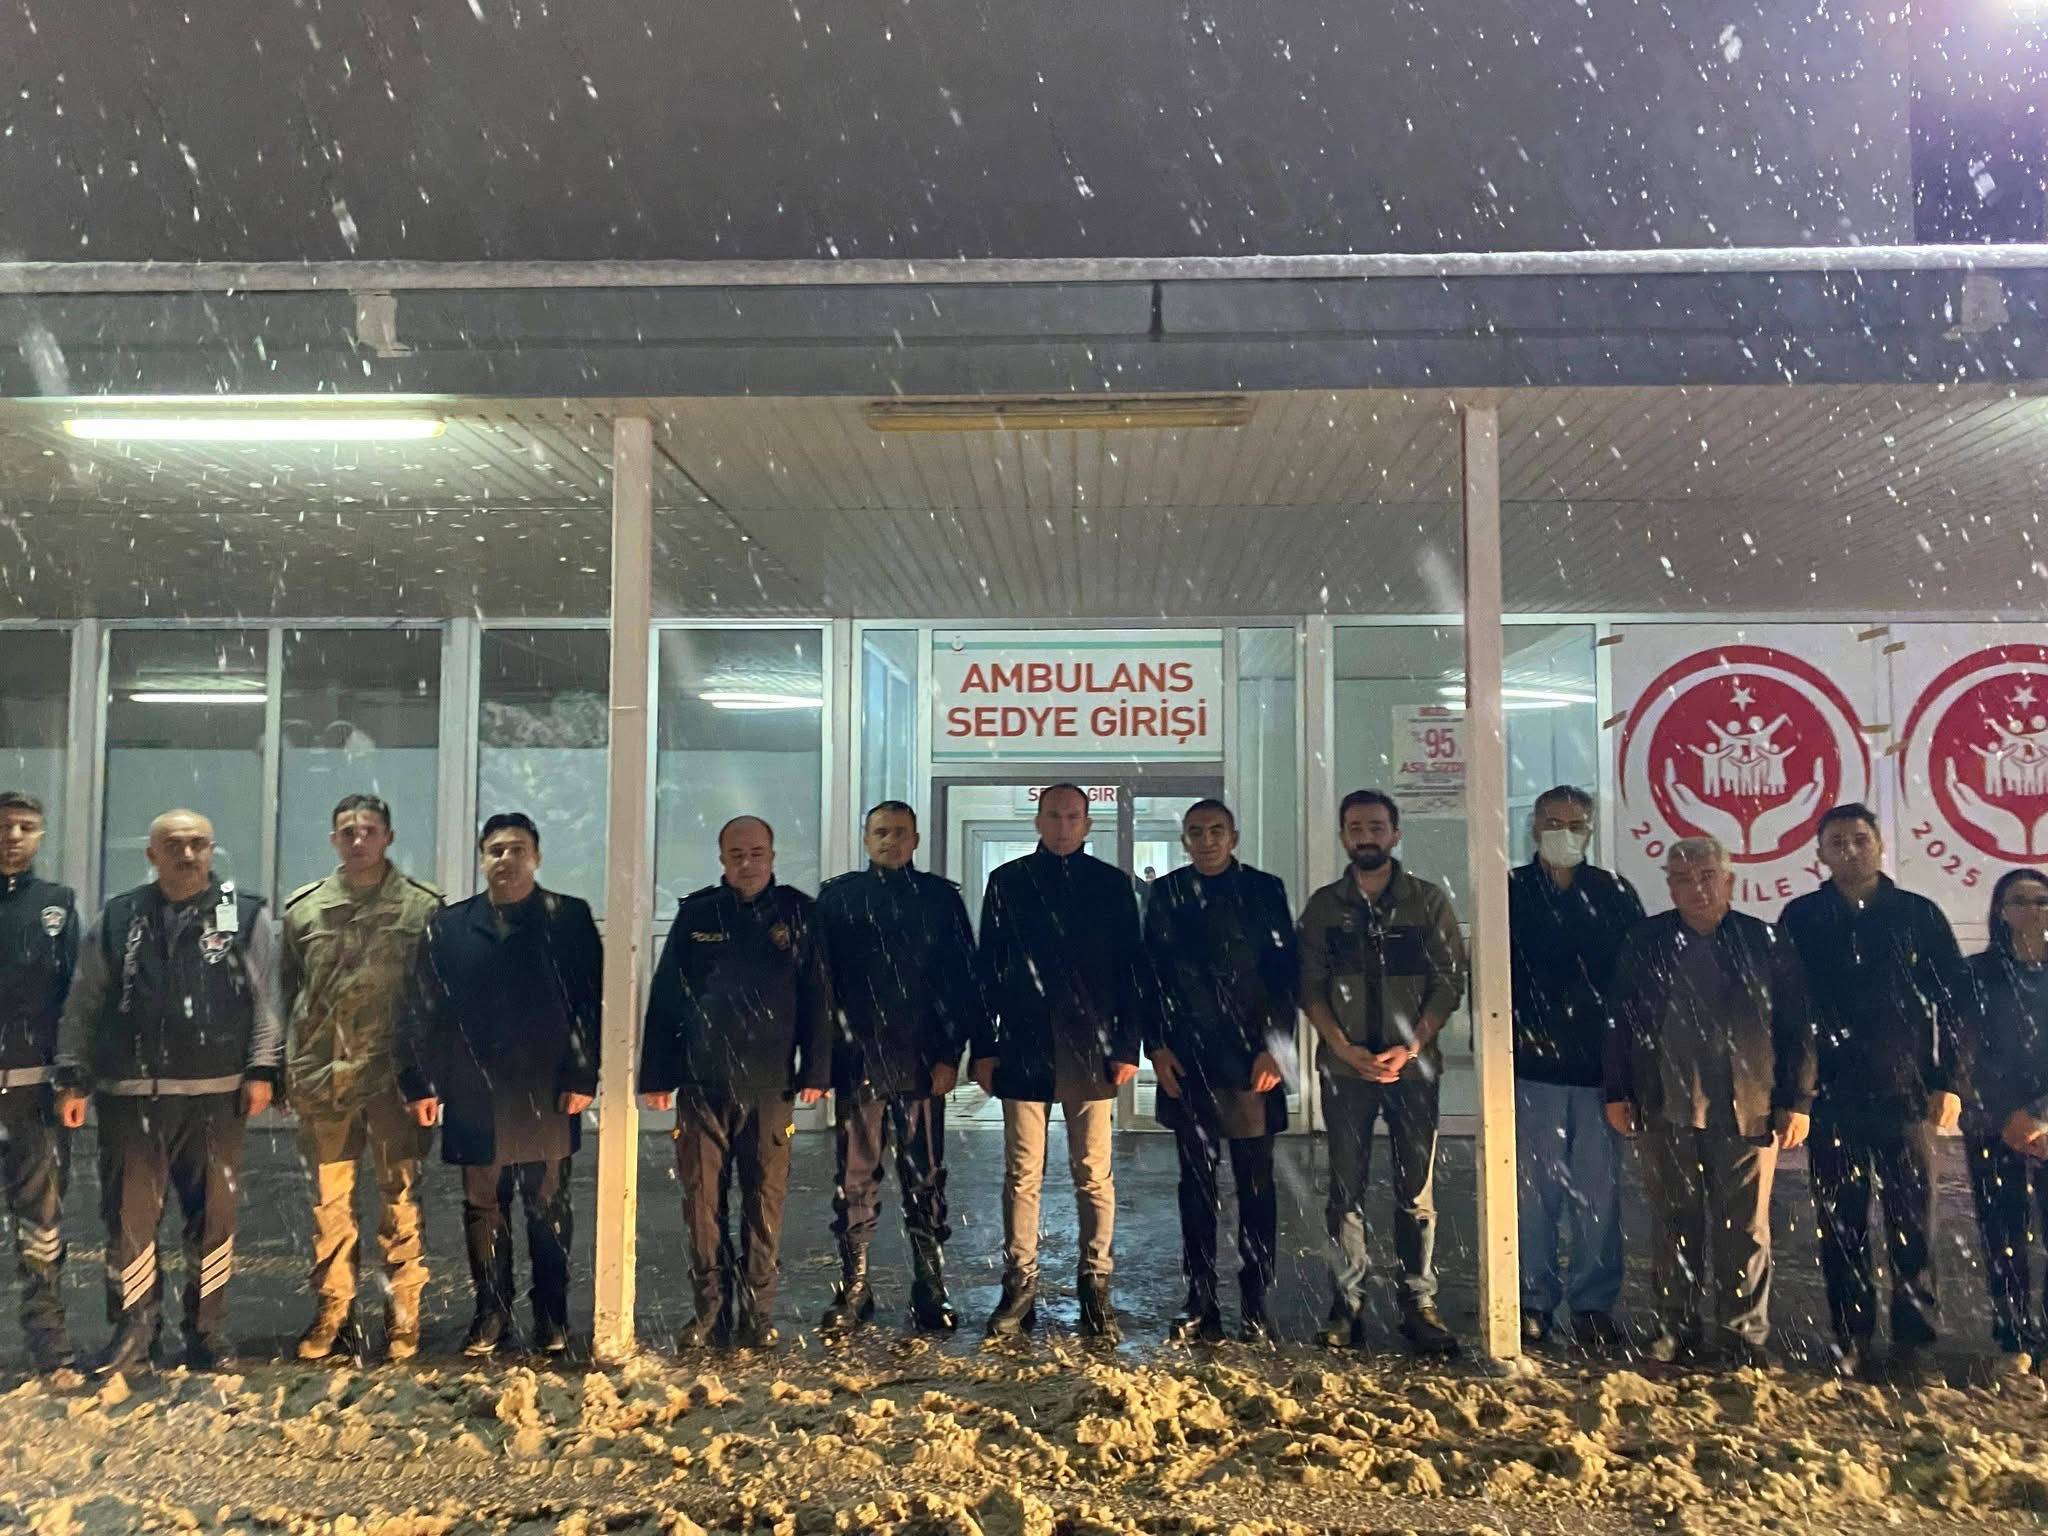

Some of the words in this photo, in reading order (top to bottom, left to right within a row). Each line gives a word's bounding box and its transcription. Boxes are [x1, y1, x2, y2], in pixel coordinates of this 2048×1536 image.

[960, 662, 1193, 693] AMBULANS
[946, 706, 1078, 737] SEDYE
[1090, 699, 1206, 744] GİRİŞİ
[1630, 821, 1665, 858] 20
[1911, 820, 1981, 887] 2025
